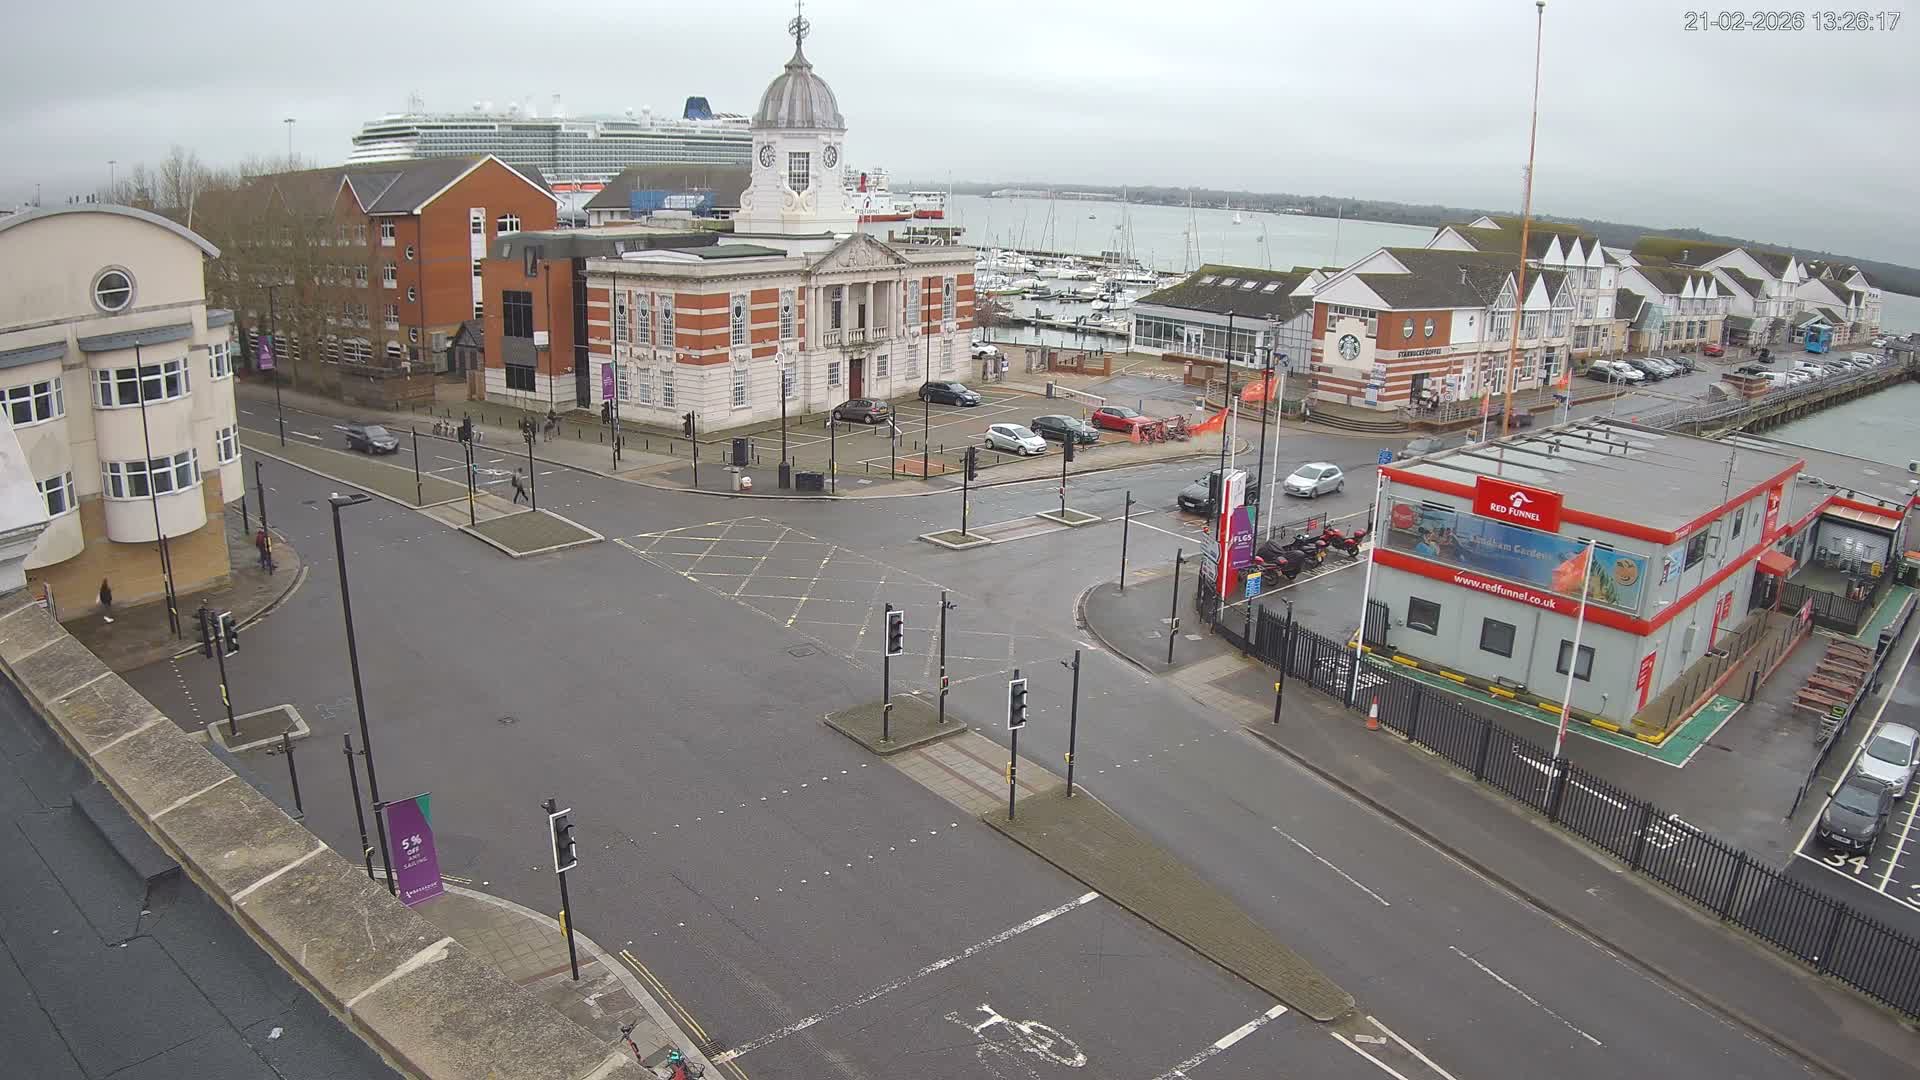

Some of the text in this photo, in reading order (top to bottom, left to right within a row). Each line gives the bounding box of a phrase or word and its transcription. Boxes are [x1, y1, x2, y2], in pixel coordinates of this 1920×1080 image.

[1490, 502, 1541, 522] RED FUNNEL
[1454, 575, 1556, 609] www.redfunnel.co.uk
[1824, 853, 1869, 874] 34
